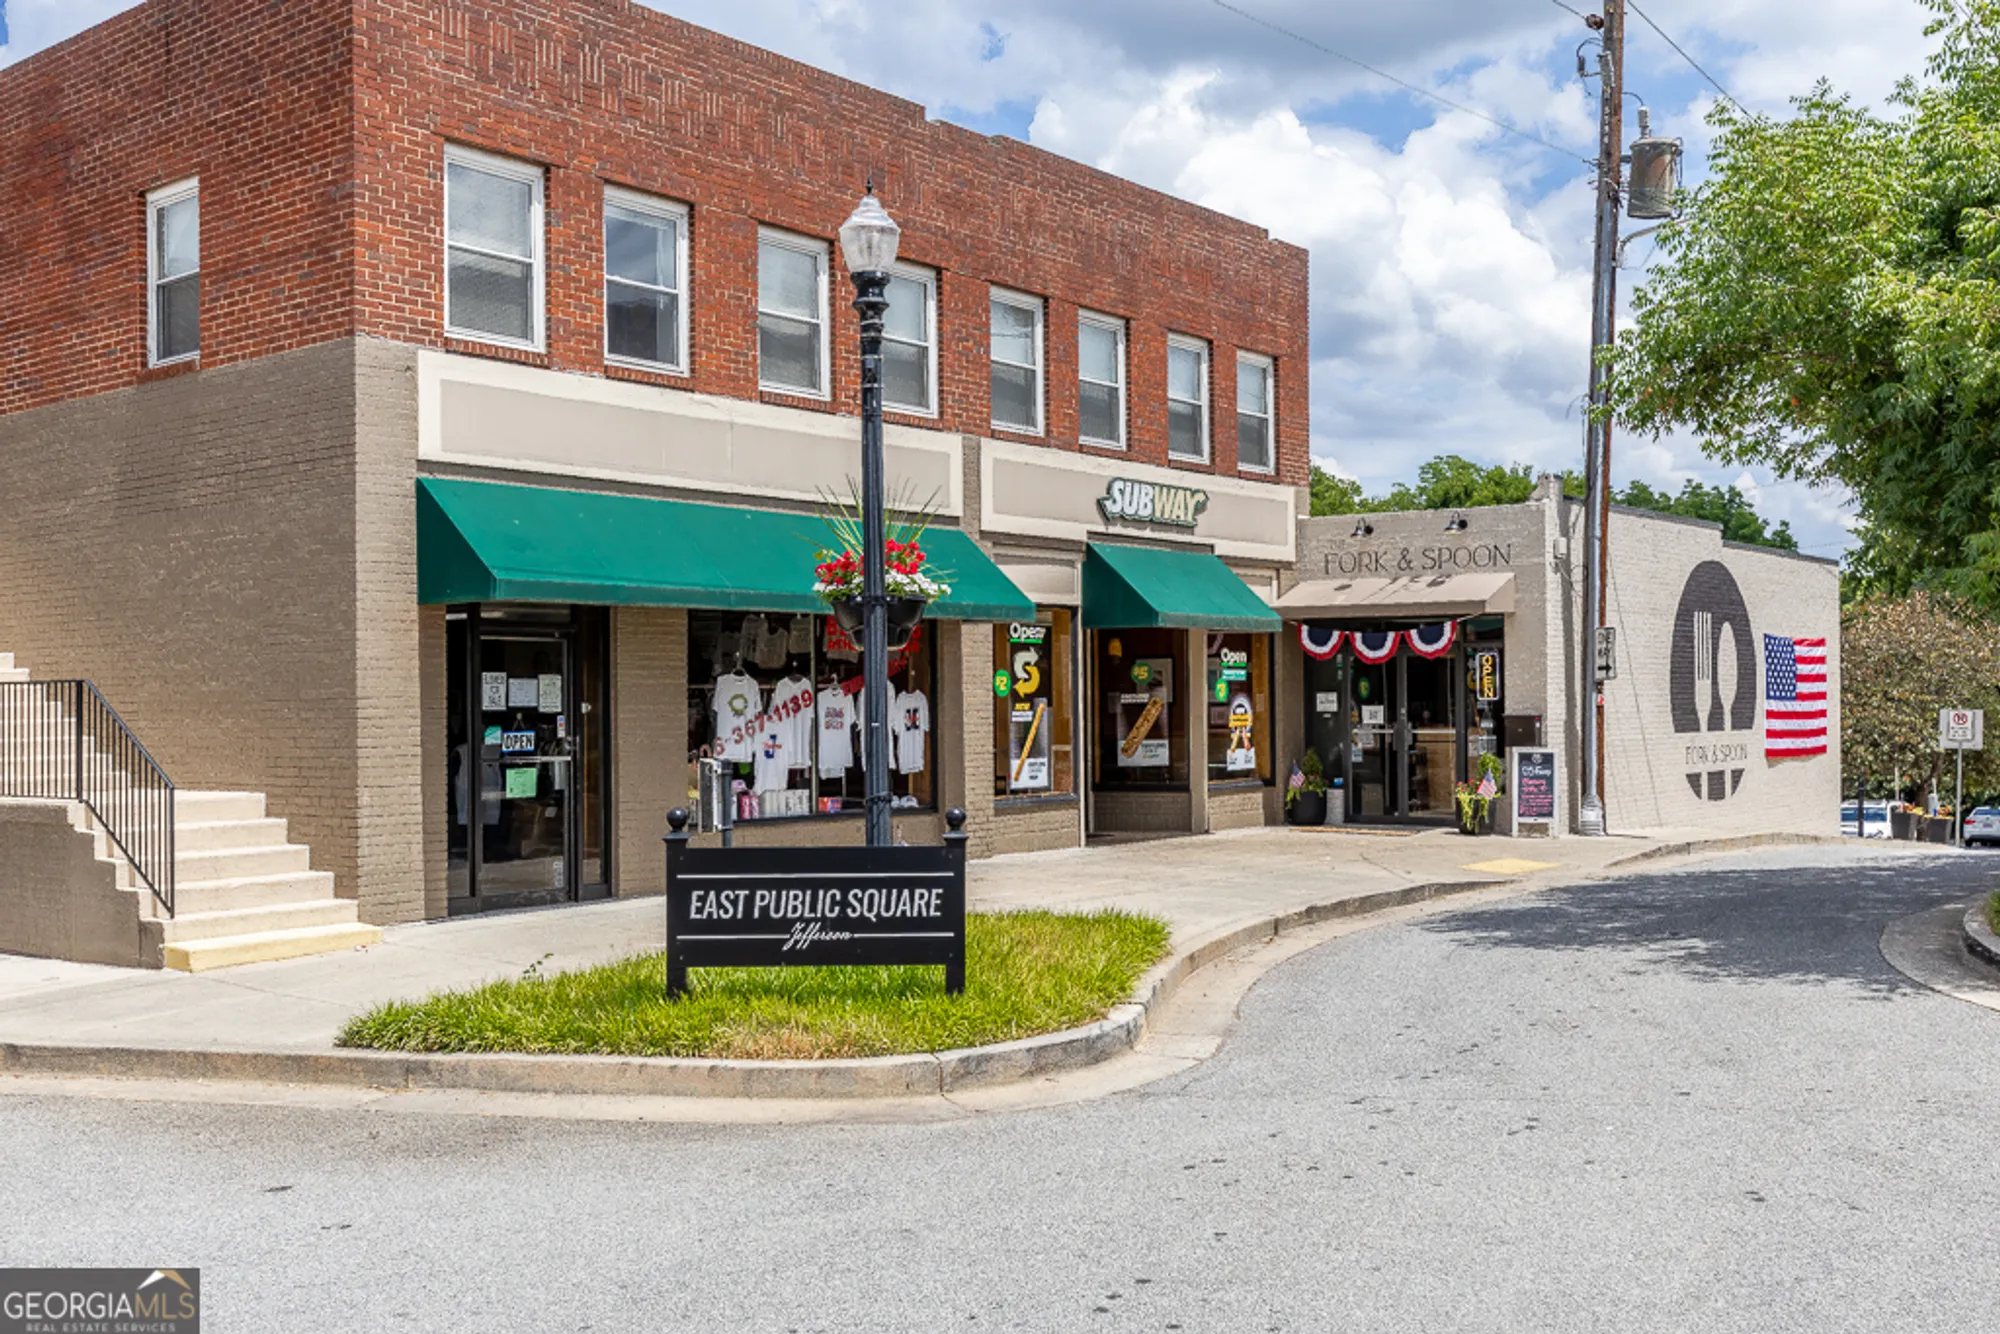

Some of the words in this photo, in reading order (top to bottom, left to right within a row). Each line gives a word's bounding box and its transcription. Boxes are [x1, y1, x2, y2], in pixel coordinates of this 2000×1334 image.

[1103, 478, 1207, 523] SUBWAY
[1324, 550, 1388, 575] FORK
[1397, 547, 1414, 571] &
[1421, 543, 1512, 570] SPOON
[1010, 622, 1046, 643] Open
[1220, 647, 1247, 666] Open
[1482, 654, 1494, 698] OPEN
[505, 733, 533, 750] OPEN
[689, 890, 750, 919] EAST
[753, 889, 842, 919] PUBLIC
[846, 888, 944, 921] SQUARE
[781, 922, 852, 951] Jefferson
